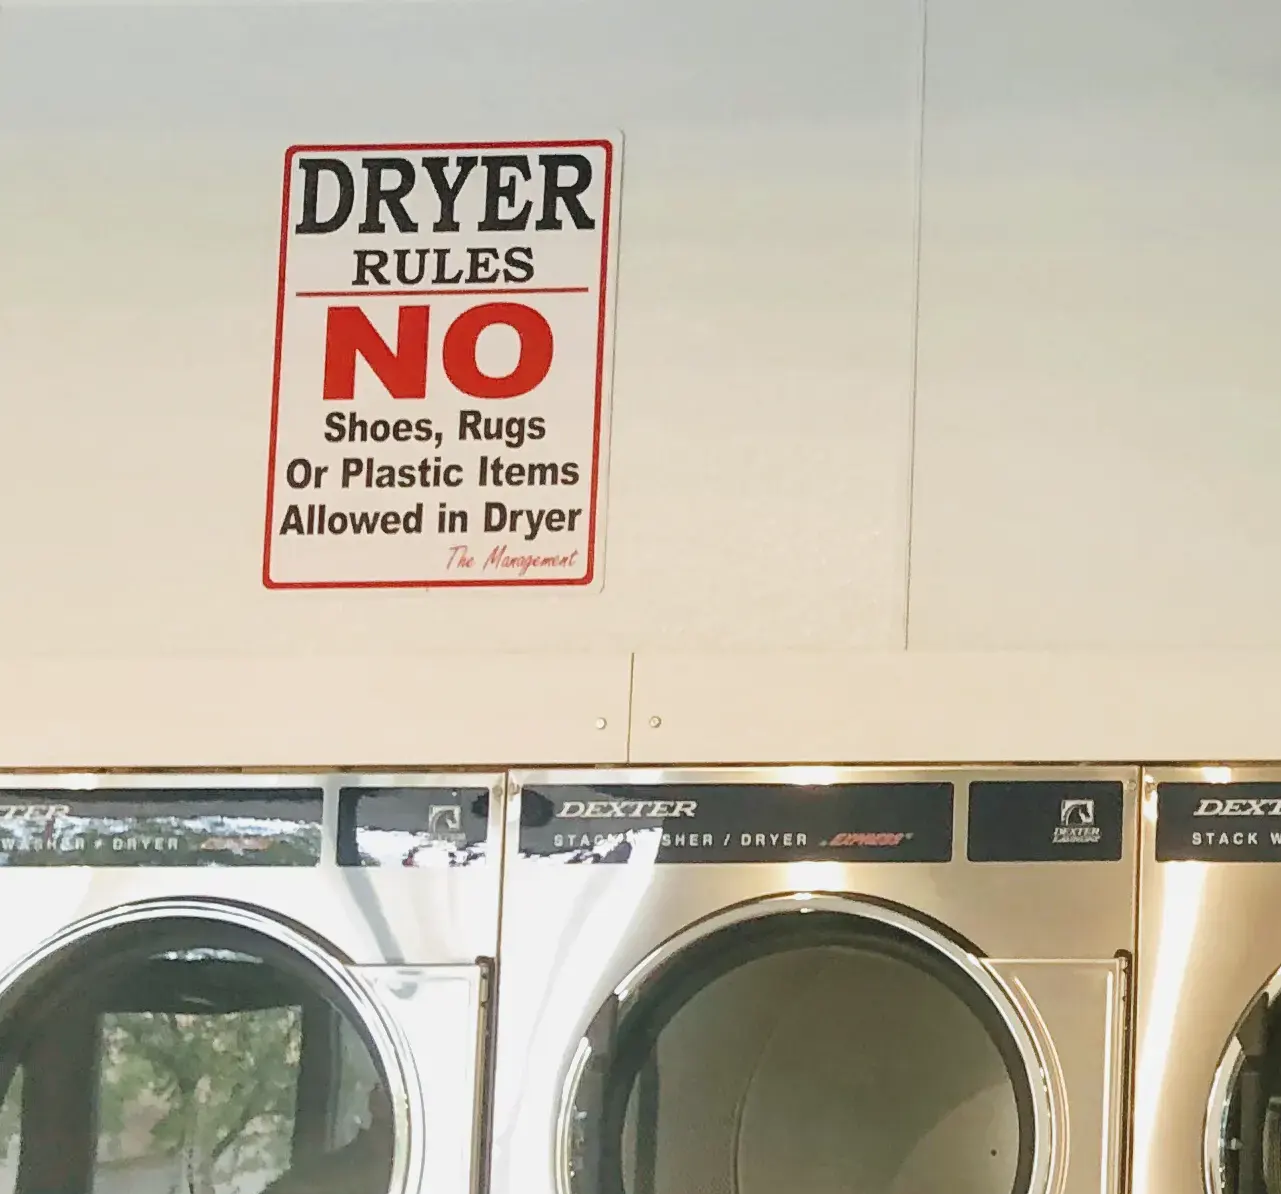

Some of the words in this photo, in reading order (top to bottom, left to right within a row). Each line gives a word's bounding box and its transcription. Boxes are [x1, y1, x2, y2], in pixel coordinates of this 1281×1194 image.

[295, 153, 595, 234] DRYER
[352, 246, 535, 286] RULES
[323, 301, 554, 400] NO
[324, 411, 443, 448] Shoes,
[459, 410, 547, 447] Rugs
[286, 457, 328, 488] Or
[342, 456, 463, 488] Plastic
[479, 456, 580, 486] Items
[280, 503, 424, 535] Allowed
[438, 503, 468, 533] in
[484, 502, 582, 540] Dryer
[446, 546, 475, 570] The
[483, 545, 578, 576] Management
[555, 801, 699, 817] DEXTER
[113, 837, 178, 850] DRYER
[740, 833, 808, 847] DRYER
[1192, 832, 1259, 846] STACK
